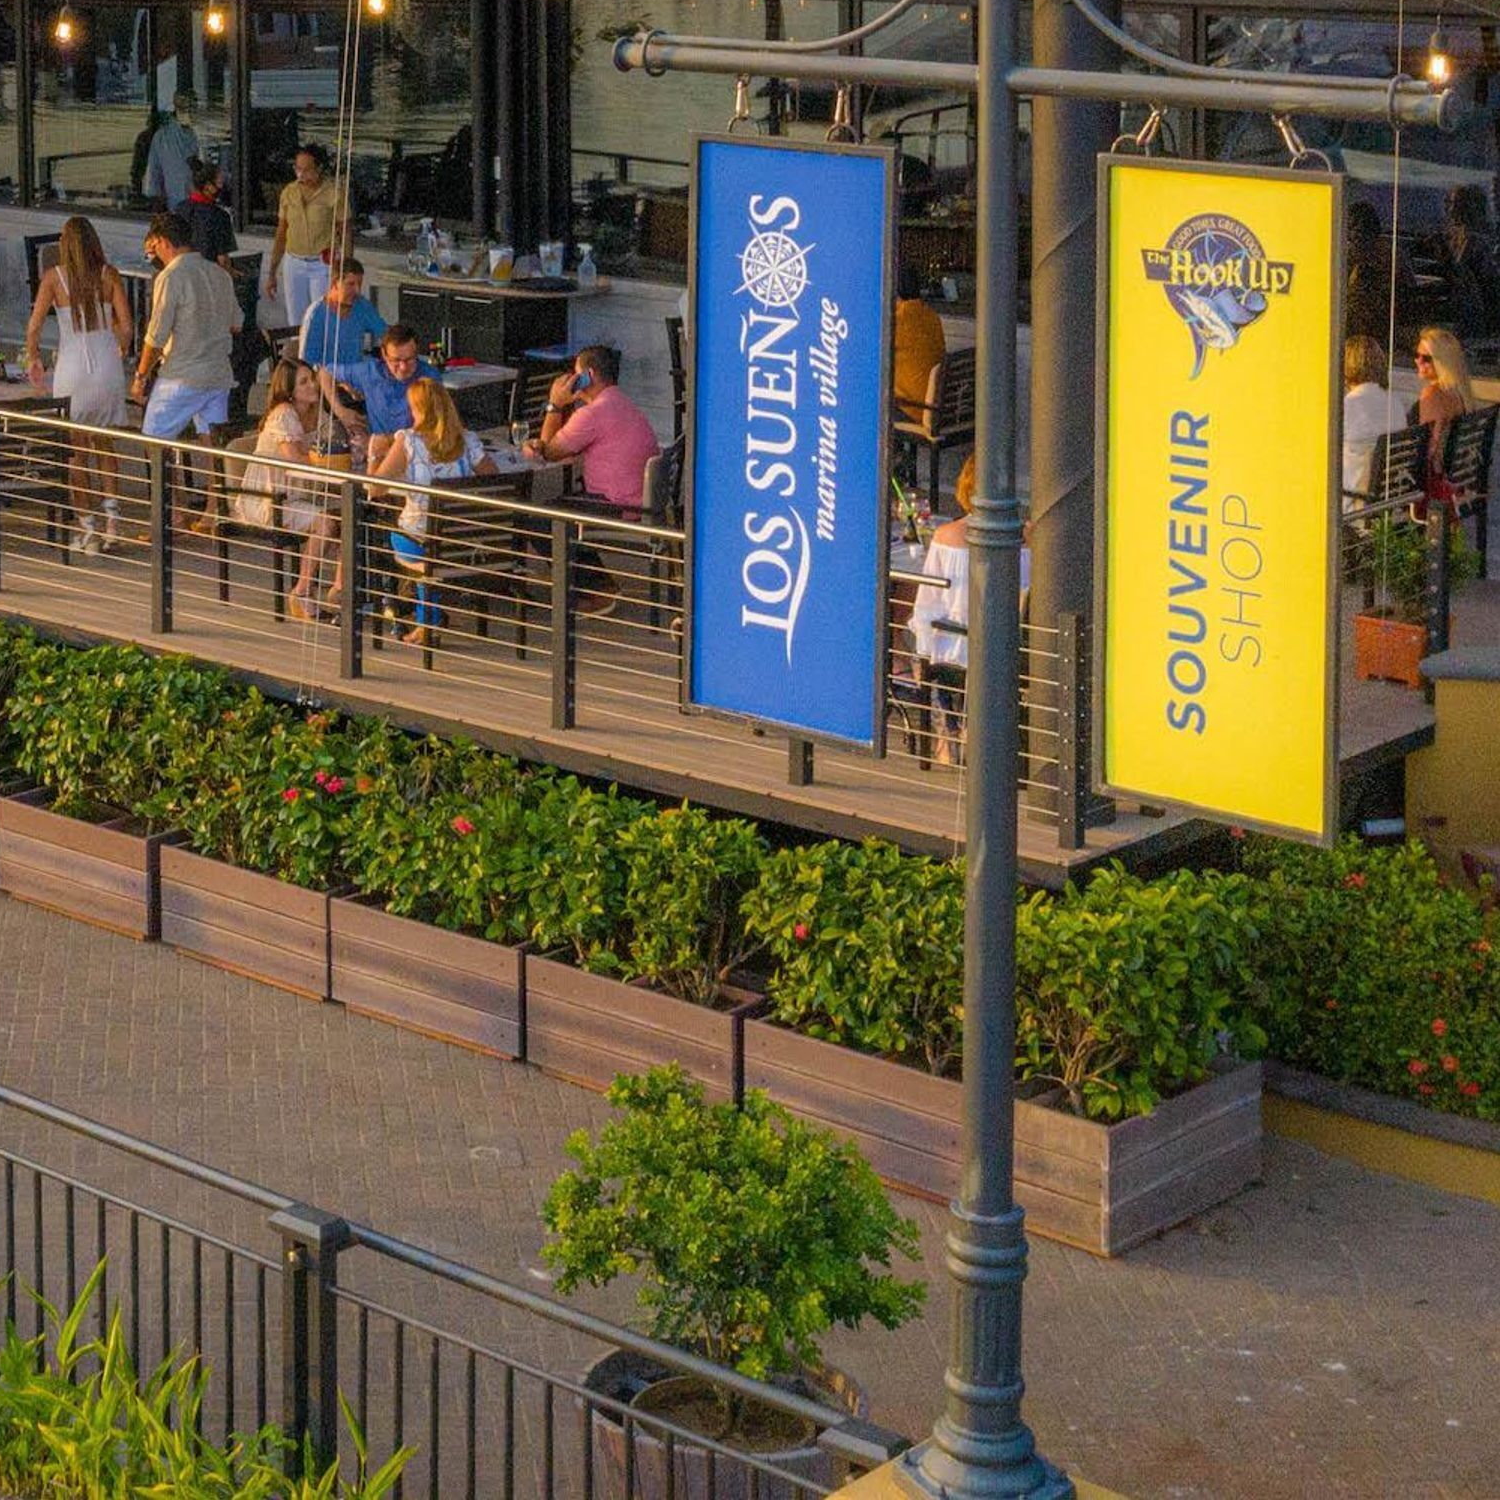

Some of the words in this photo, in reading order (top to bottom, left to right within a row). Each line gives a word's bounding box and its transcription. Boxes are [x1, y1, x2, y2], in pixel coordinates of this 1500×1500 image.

[1147, 251, 1170, 265] The
[1249, 258, 1290, 294] Up
[808, 297, 848, 407] village
[811, 415, 838, 541] marina
[741, 504, 811, 668] LOS
[1166, 410, 1210, 735] SOUVENIR
[1219, 494, 1263, 668] SHOP
